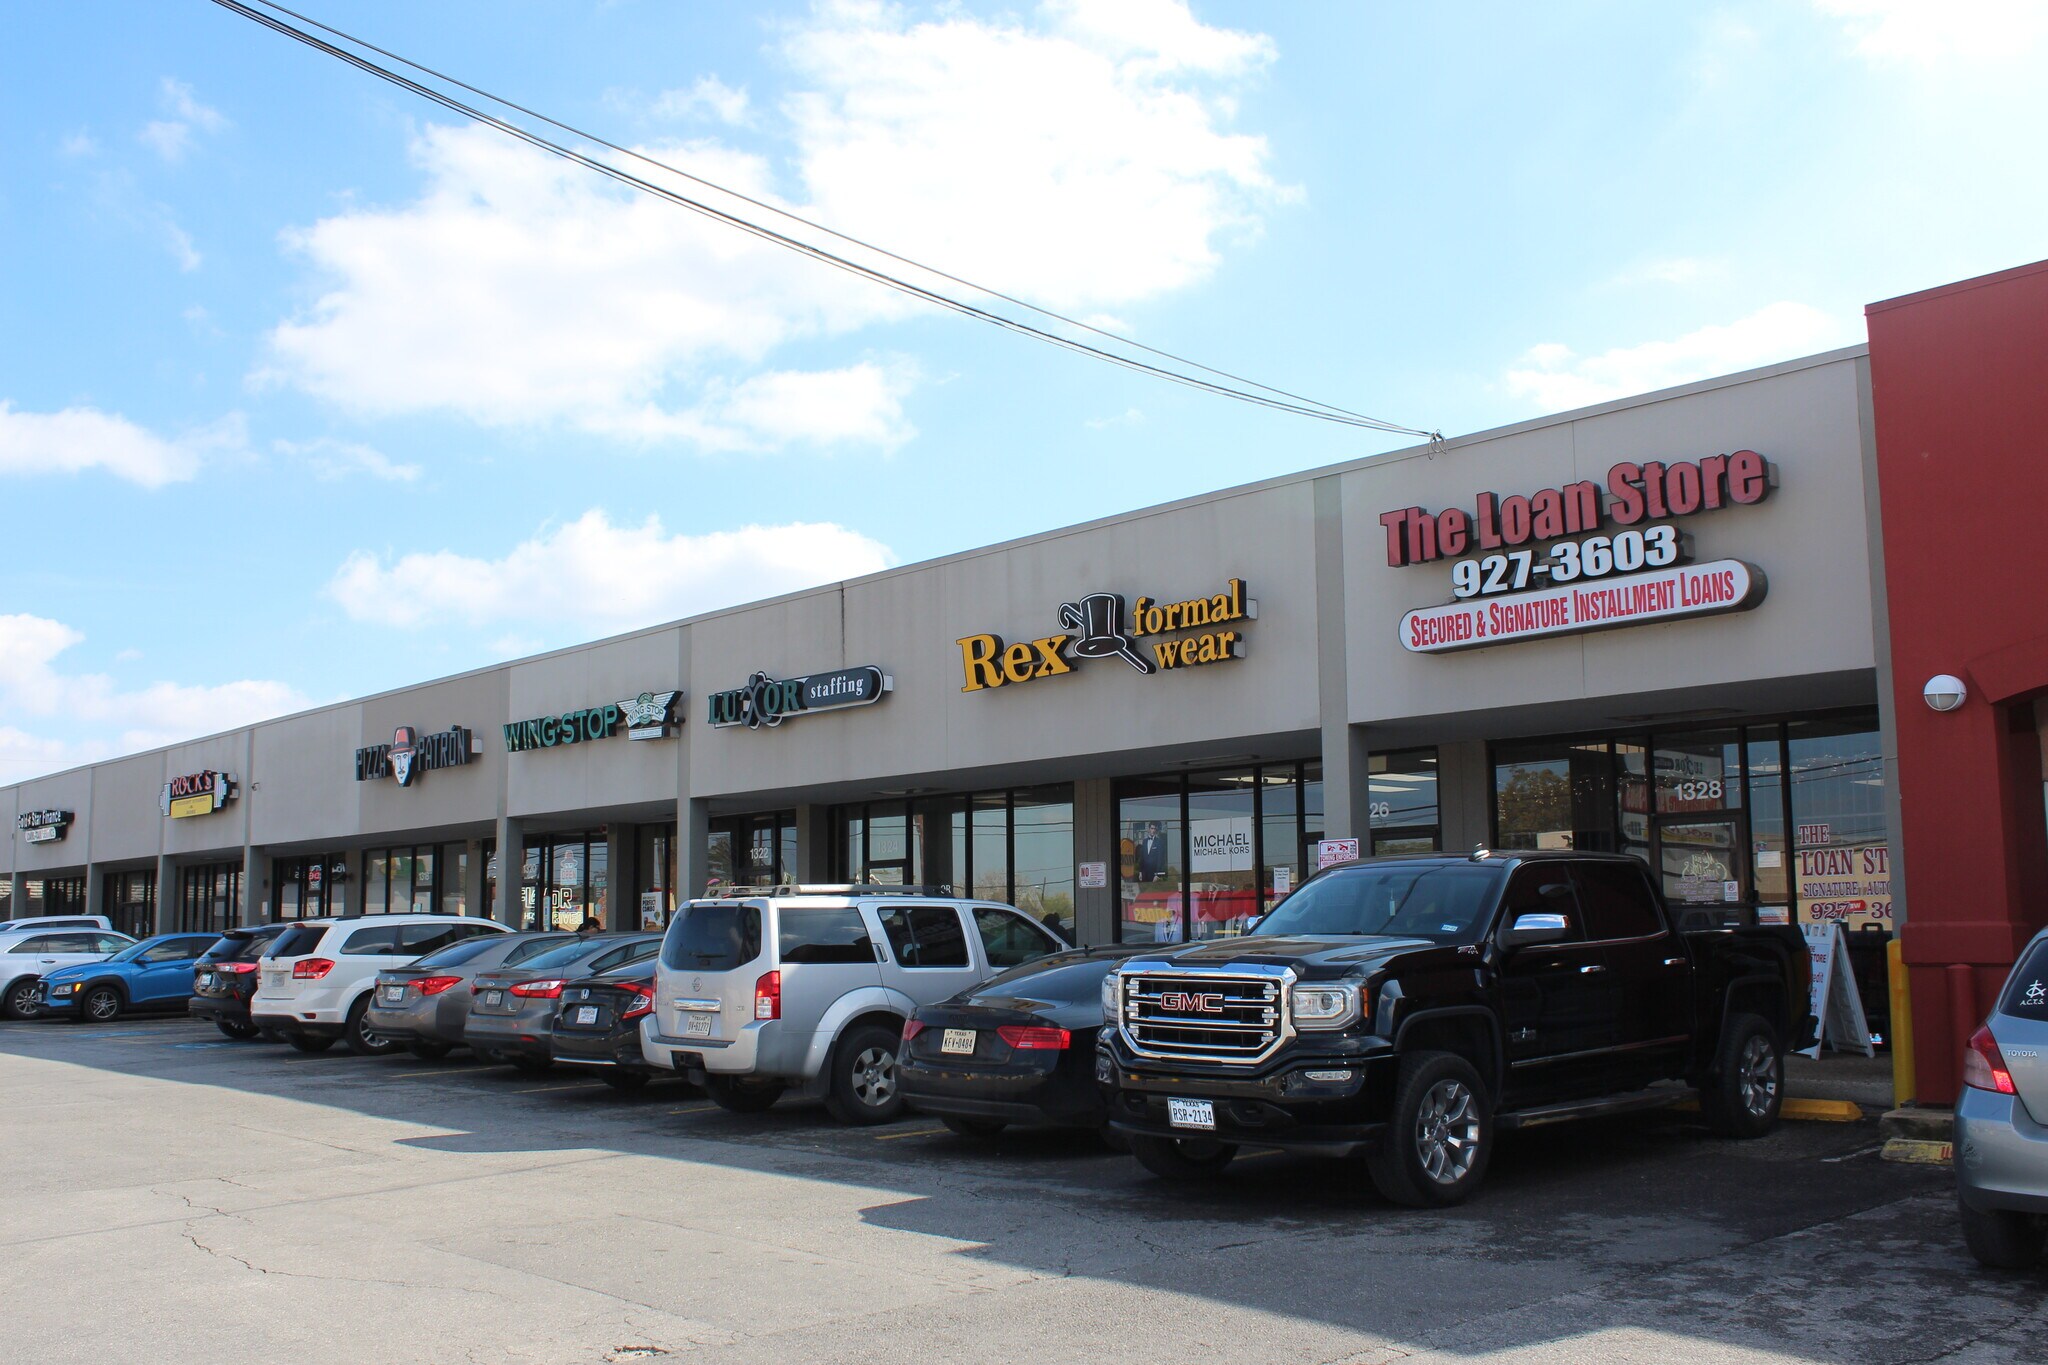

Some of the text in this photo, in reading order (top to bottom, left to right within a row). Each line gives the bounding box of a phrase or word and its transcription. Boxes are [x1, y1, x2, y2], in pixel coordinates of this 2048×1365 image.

[1380, 450, 1767, 568] The Loan Store
[1452, 525, 1678, 598] 927-3603
[1132, 578, 1243, 636] formal
[1410, 570, 1735, 648] SECURED & SIGNATURE INSTALLMENT LOANS
[1152, 631, 1235, 670] wear
[956, 633, 1070, 693] Rex
[810, 675, 864, 697] staffing
[356, 744, 389, 781] PIZZA
[1674, 780, 1722, 801] 1328
[1193, 833, 1250, 848] MICHAEL
[1799, 825, 1829, 844] THE
[750, 847, 769, 860] 1322
[1193, 845, 1250, 857] MICHAEL KORS
[1801, 849, 1853, 876] LOAN
[1811, 902, 1849, 920] 927
[1161, 992, 1223, 1012] GMC
[2007, 1049, 2038, 1057] TOYOTA
